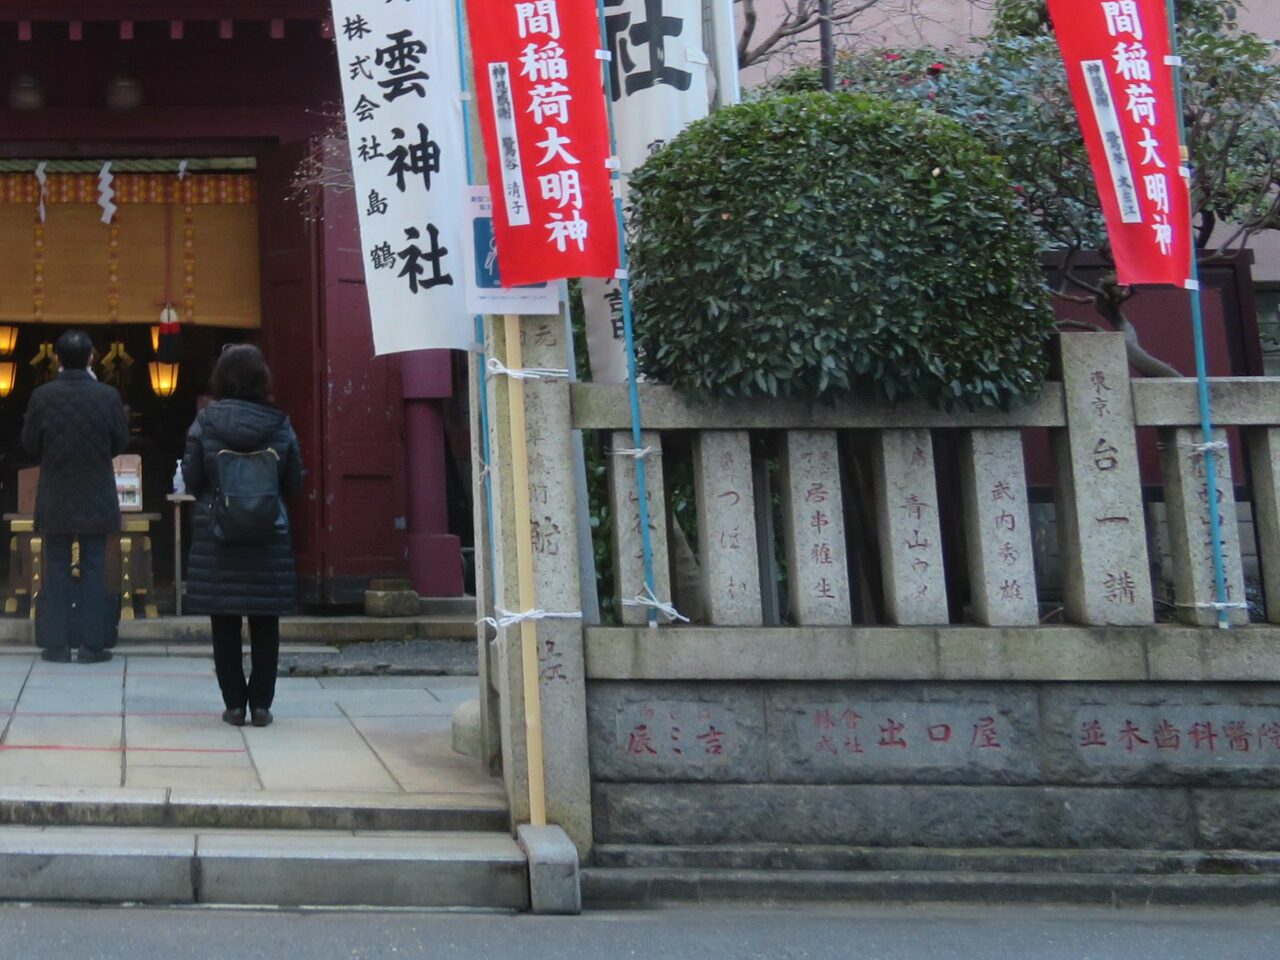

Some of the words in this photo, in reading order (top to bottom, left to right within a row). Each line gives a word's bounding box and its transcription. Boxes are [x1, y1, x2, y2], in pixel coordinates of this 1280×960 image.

[342, 14, 383, 162] 株式会社
[1090, 370, 1112, 417] 東京
[991, 481, 1023, 601] 武内秀雄
[1092, 437, 1136, 605] 台一講
[878, 715, 1001, 749] 出口屋
